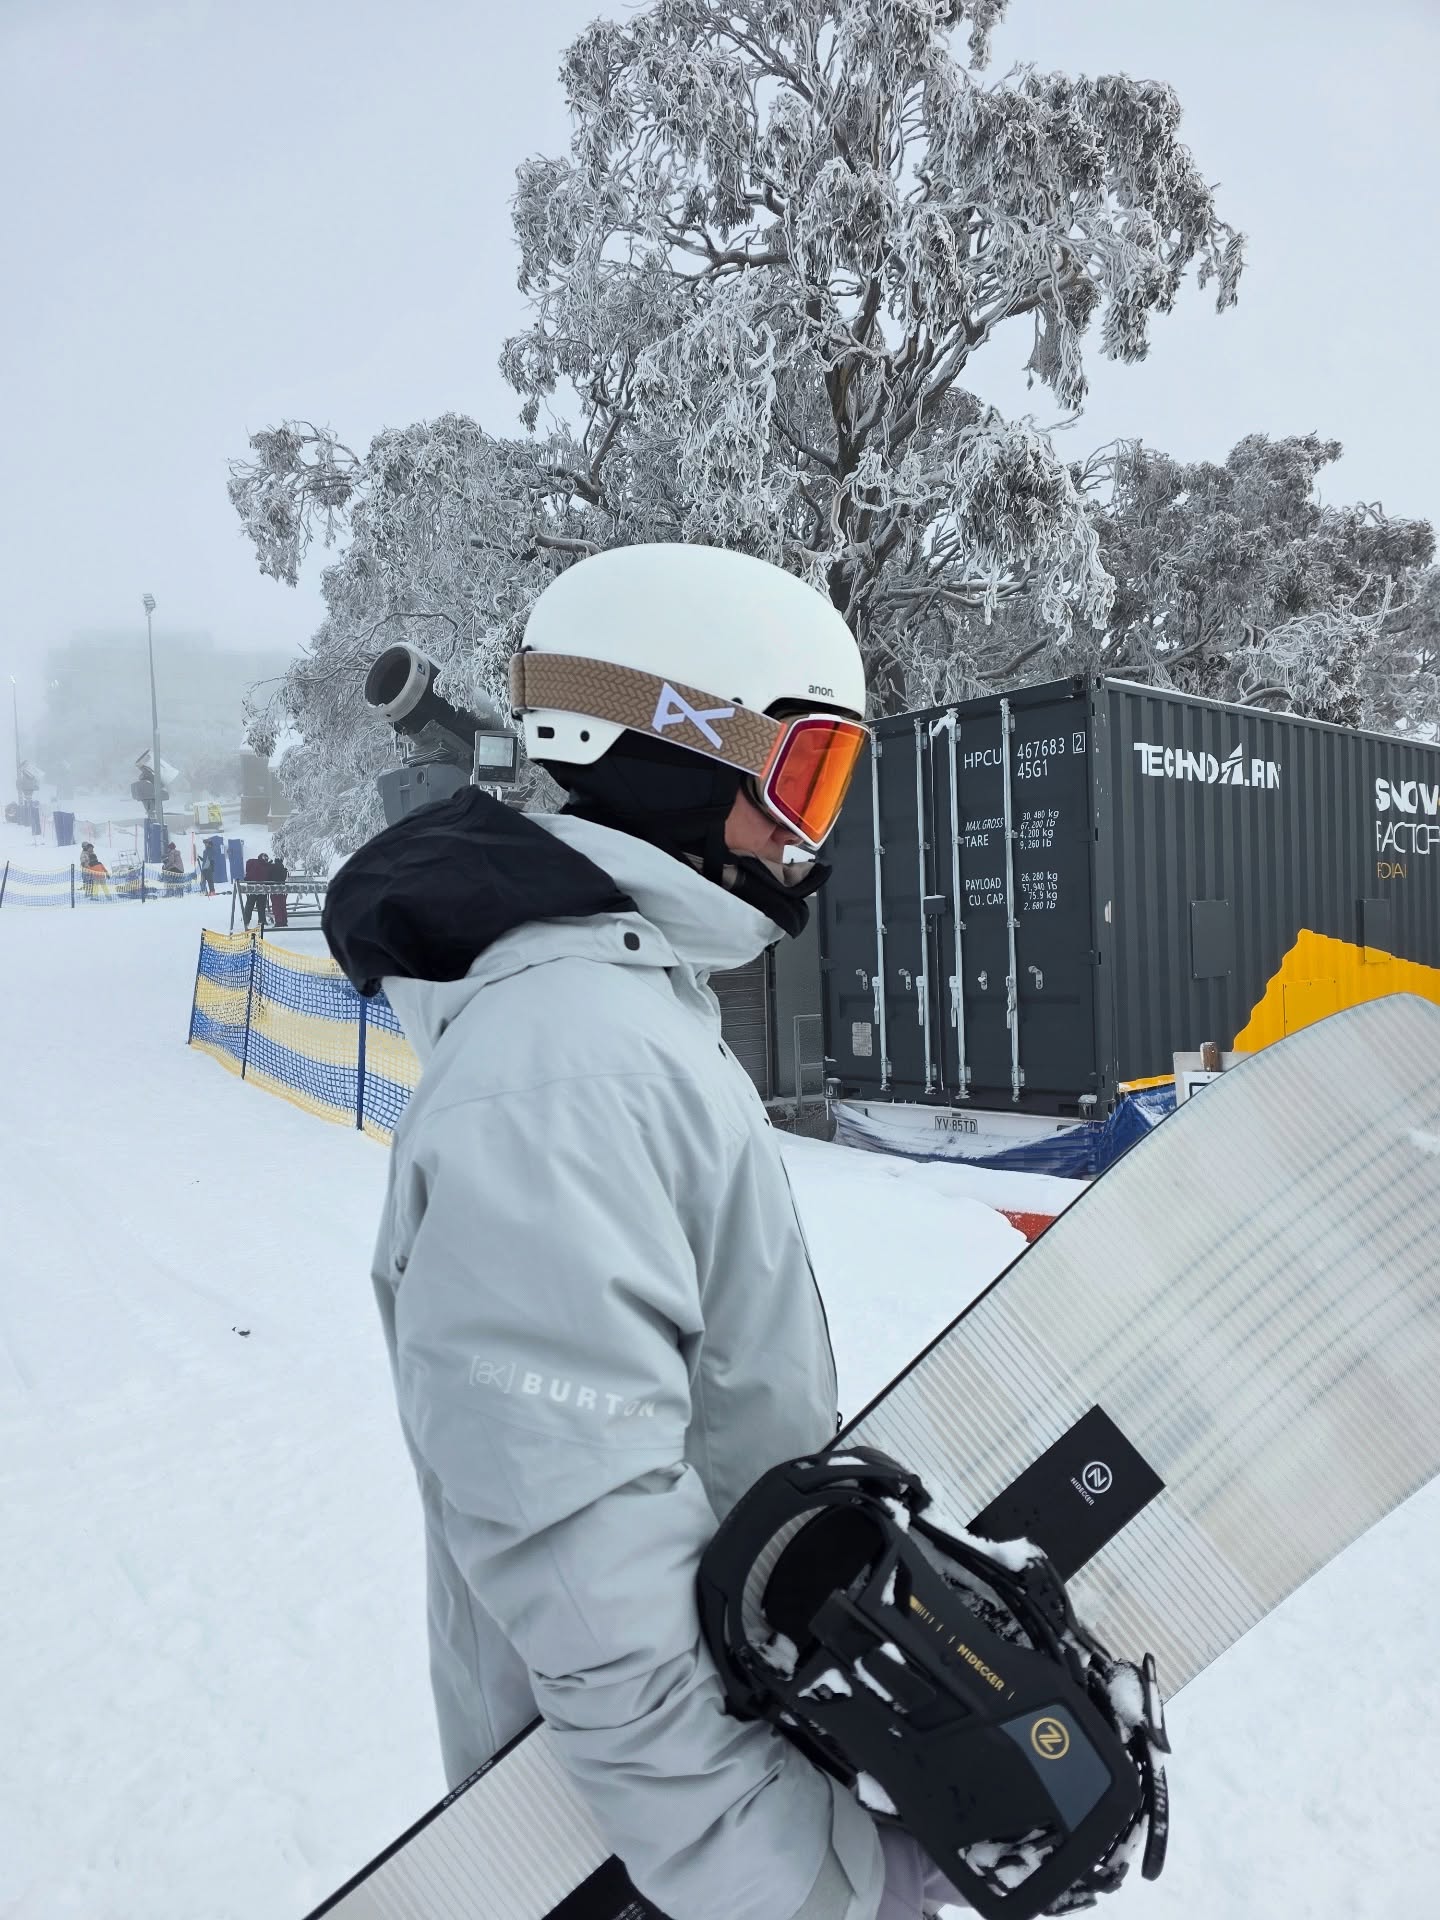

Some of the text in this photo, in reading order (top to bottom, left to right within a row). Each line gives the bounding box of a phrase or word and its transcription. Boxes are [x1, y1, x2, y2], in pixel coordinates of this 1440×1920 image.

[964, 748, 1002, 769] HPCU
[1017, 737, 1065, 760] 467683
[1017, 759, 1048, 779] 45G1
[1048, 808, 1060, 819] kg
[1046, 818, 1056, 828] lb
[964, 833, 989, 848] TARE
[1042, 828, 1054, 838] kg
[1042, 838, 1052, 848] lb
[965, 877, 1002, 891] PAYLOAD
[1047, 870, 1058, 882] kg
[1047, 881, 1058, 890] lb
[1046, 890, 1058, 901] kg
[1046, 900, 1056, 909] lb
[1070, 1476, 1095, 1507] NIDECKER
[956, 1643, 1006, 1692] NIDECKER
